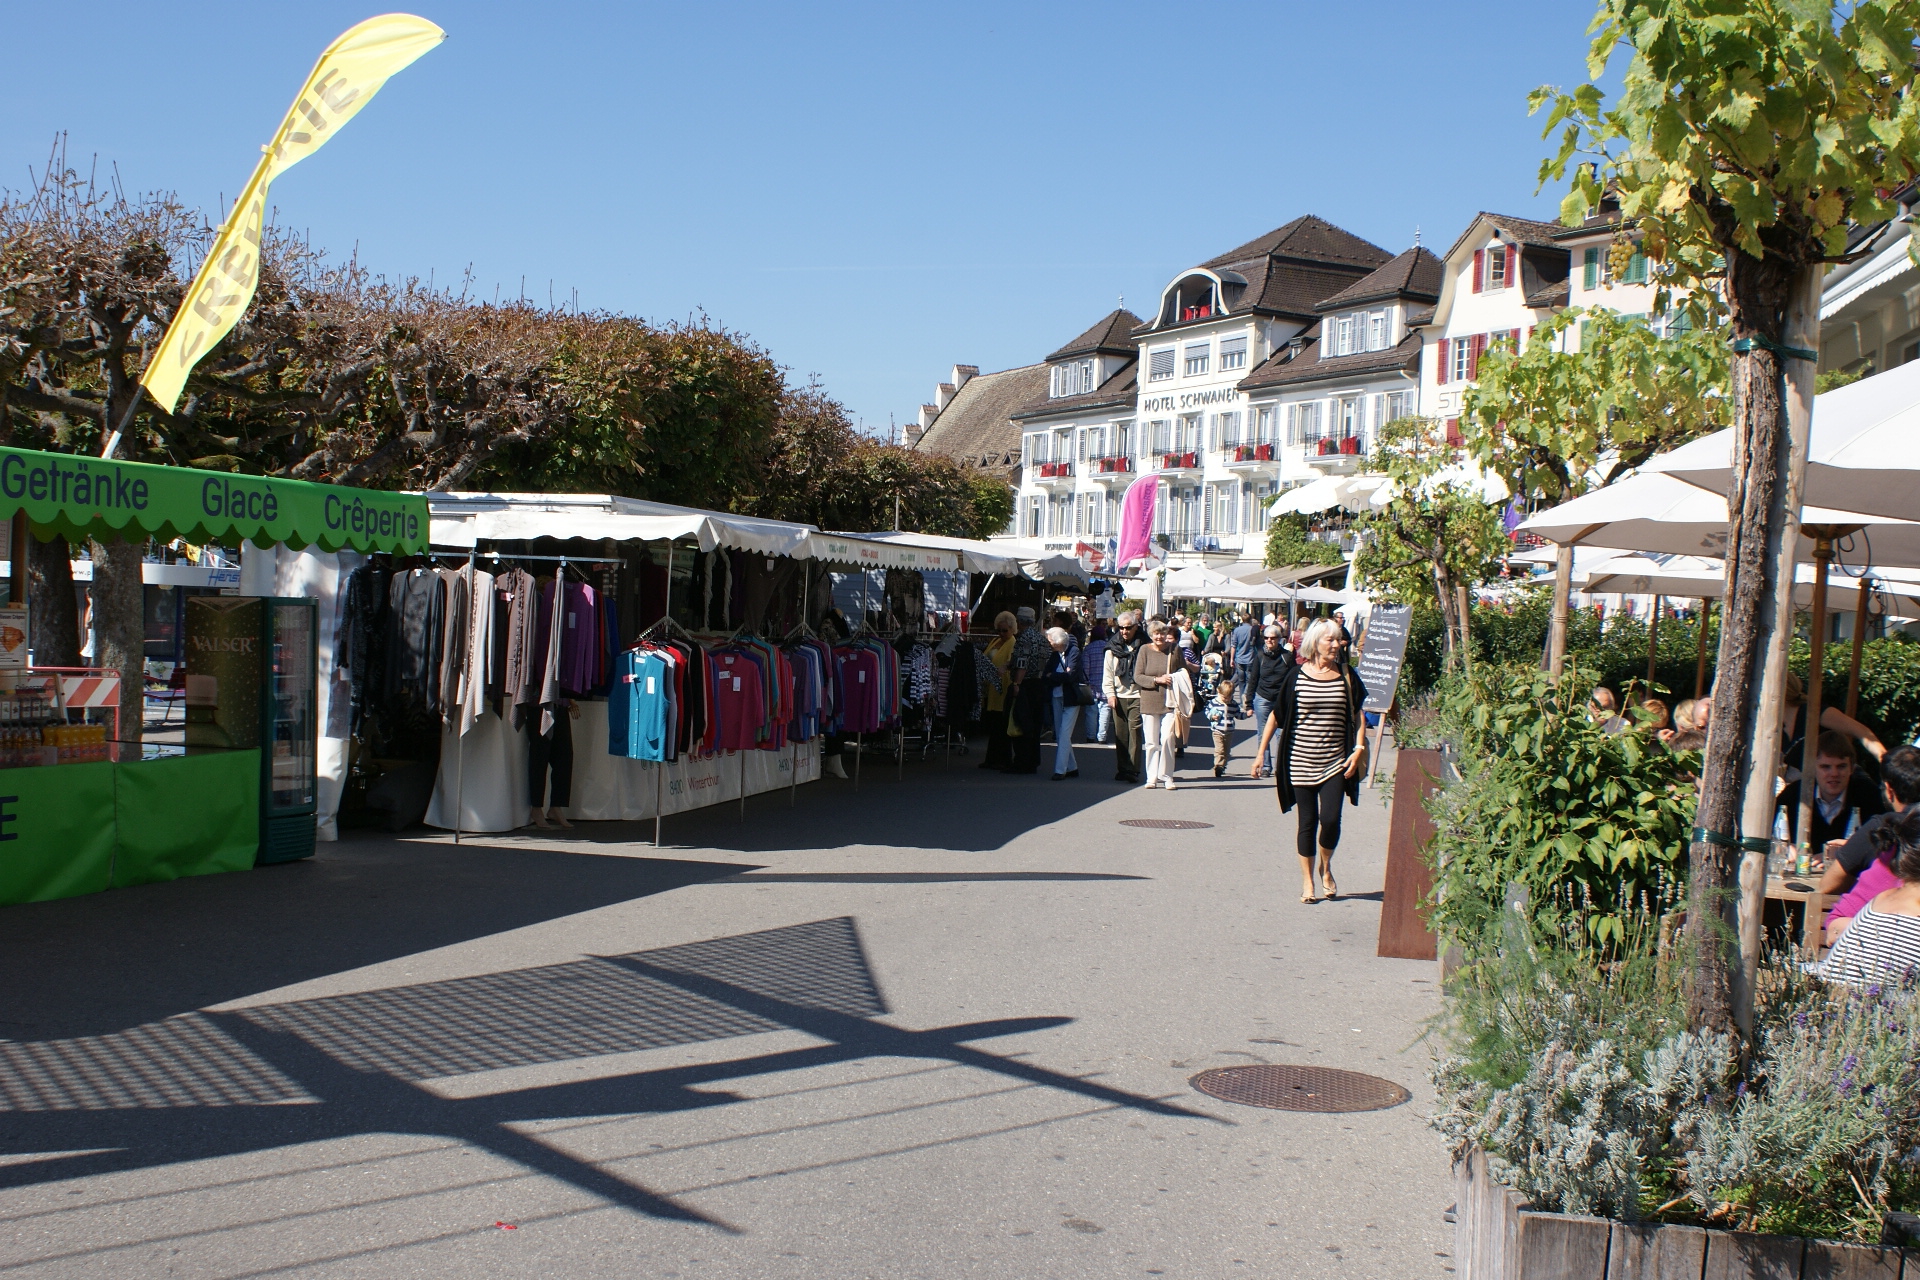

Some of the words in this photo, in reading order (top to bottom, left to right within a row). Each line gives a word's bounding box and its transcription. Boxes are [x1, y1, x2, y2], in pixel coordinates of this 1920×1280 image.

[1144, 396, 1176, 412] HOTEL
[1180, 387, 1240, 409] SCHWANEN
[2, 454, 149, 511] Getränke
[202, 477, 279, 522] Glacè
[324, 493, 419, 541] Crêperie
[192, 635, 253, 654] VALSER
[687, 772, 720, 791] Winterthur
